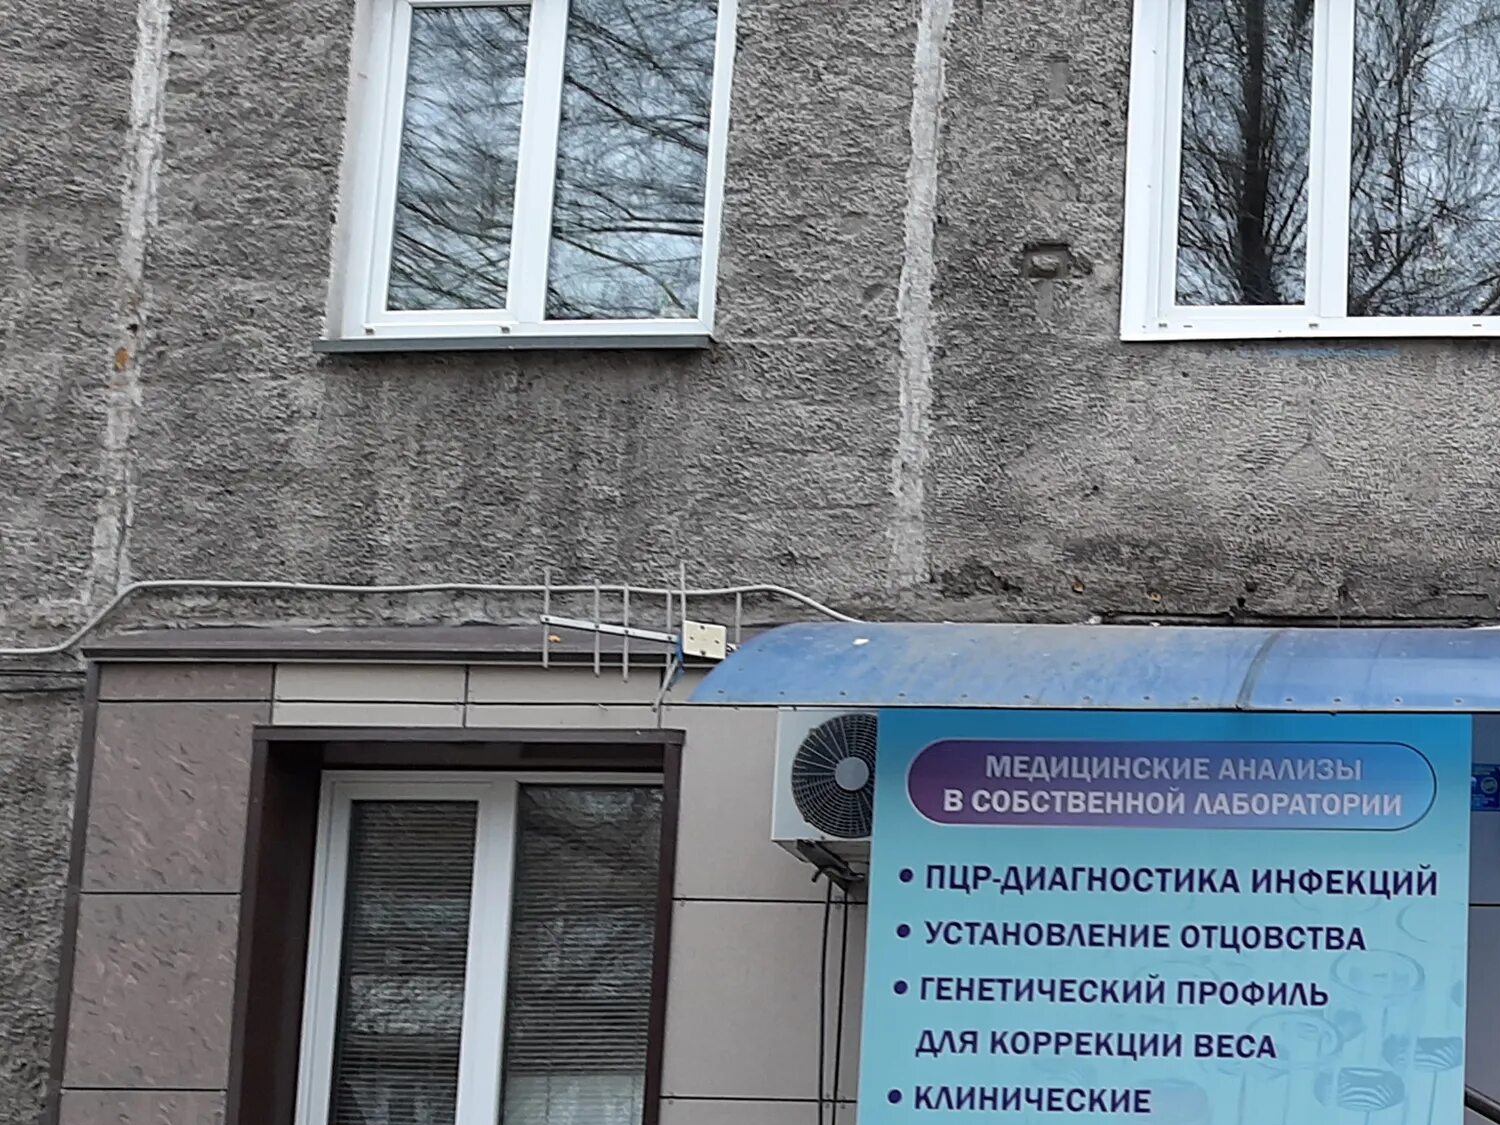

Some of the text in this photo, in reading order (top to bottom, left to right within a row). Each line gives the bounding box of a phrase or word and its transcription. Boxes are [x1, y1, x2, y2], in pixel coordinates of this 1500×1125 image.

[986, 757, 1363, 783] МЕДИЦИНСКИЕ АНАЛИЗЫ
[944, 785, 1403, 816] В СОБСТВЕННОЙ ЛАБОРАТОРИИ
[926, 864, 1438, 899] ПЦР-ДИАГНОСТИКА ИНФЕКЦИЙ
[925, 921, 1366, 952] УСТАНОВЛЕНИЕ ОТЦОВСТВА
[920, 972, 1329, 1007] ГЕНЕТИЧЕСКИЙ ПРОФИЛЬ
[915, 1030, 1277, 1060] ДЛЯ КОРРЕКЦИИ ВЕСА
[914, 1086, 1152, 1113] КЛИНИЧЕСКИЕ
